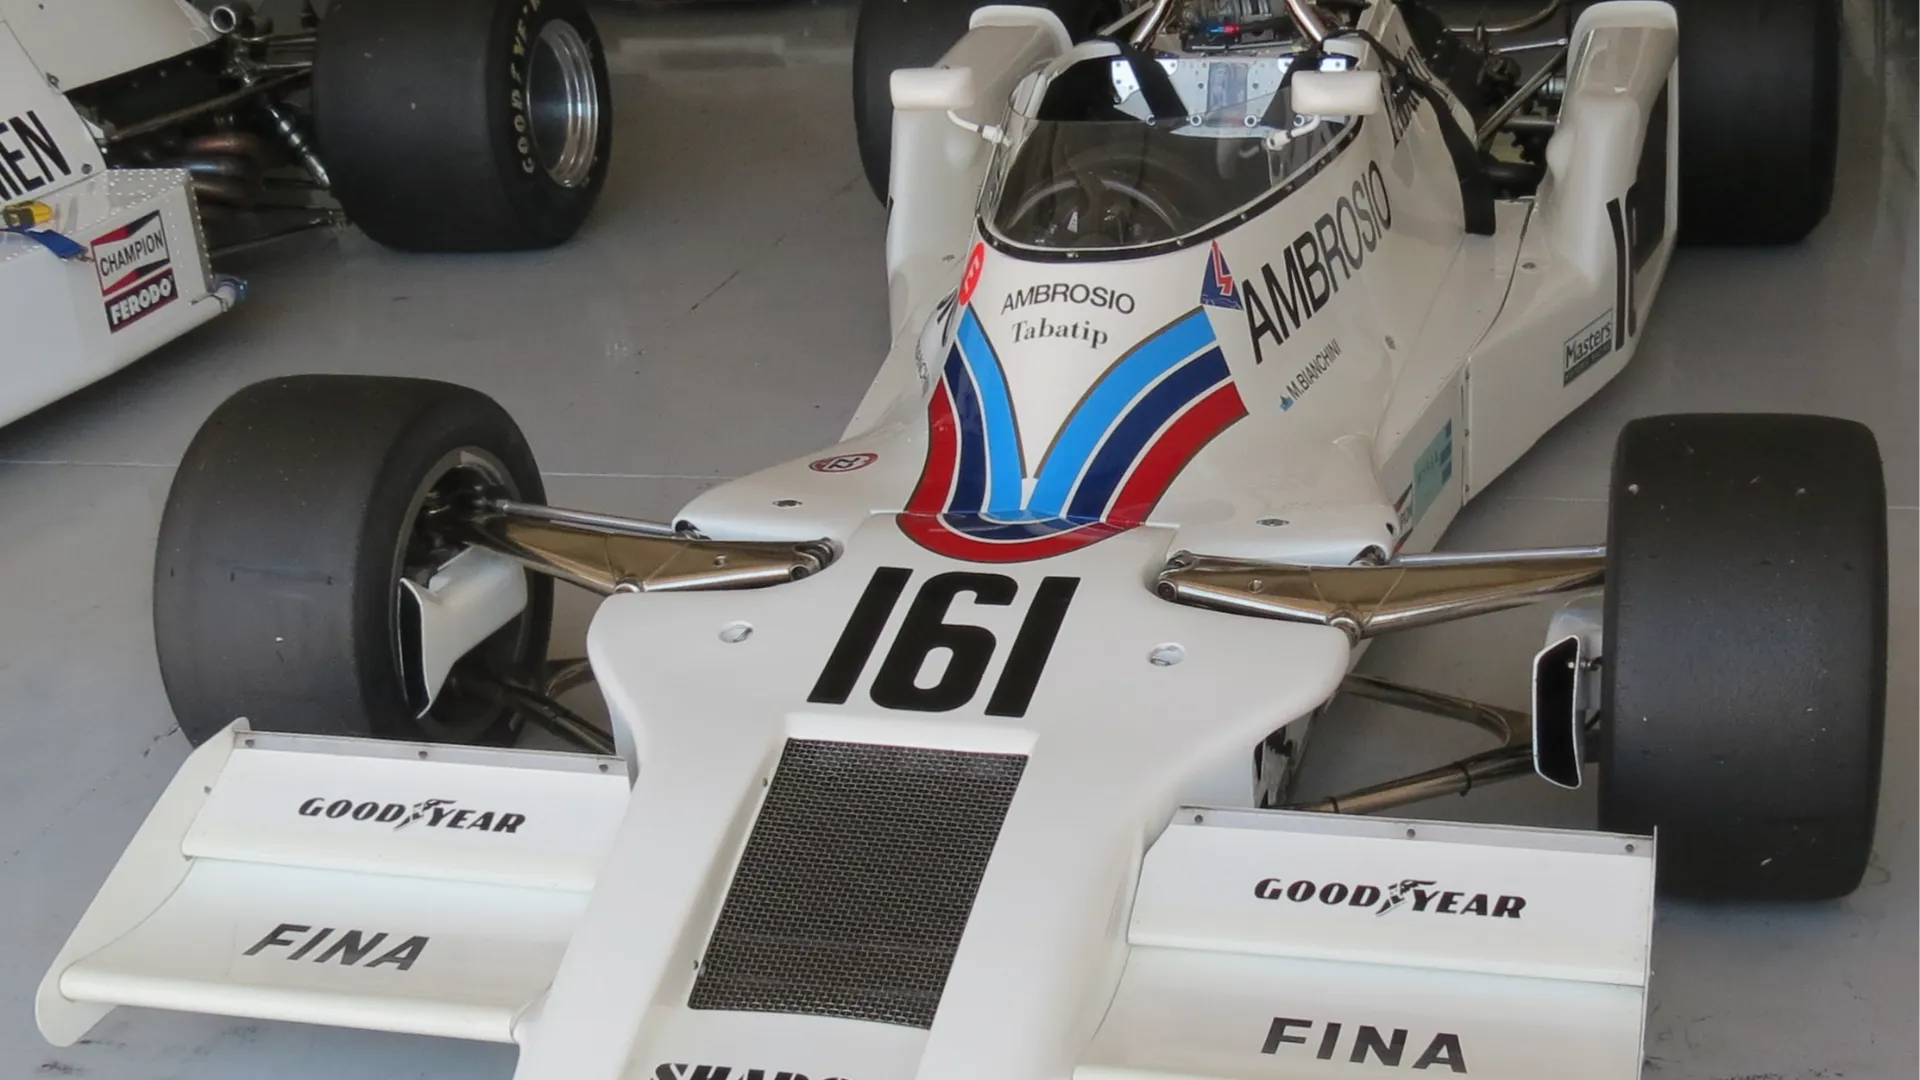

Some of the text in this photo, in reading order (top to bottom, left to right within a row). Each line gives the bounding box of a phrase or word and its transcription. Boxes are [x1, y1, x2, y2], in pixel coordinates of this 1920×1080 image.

[100, 228, 164, 277] CHAMPION
[1241, 160, 1391, 365] AMBROSIO
[110, 278, 172, 325] FERODO
[1001, 283, 1136, 315] AMBROSIO
[1011, 317, 1109, 349] Tabatip
[1565, 321, 1611, 369] Masters
[806, 566, 1081, 718] 161
[242, 923, 430, 970] FINA
[1260, 1016, 1467, 1073] FINA
